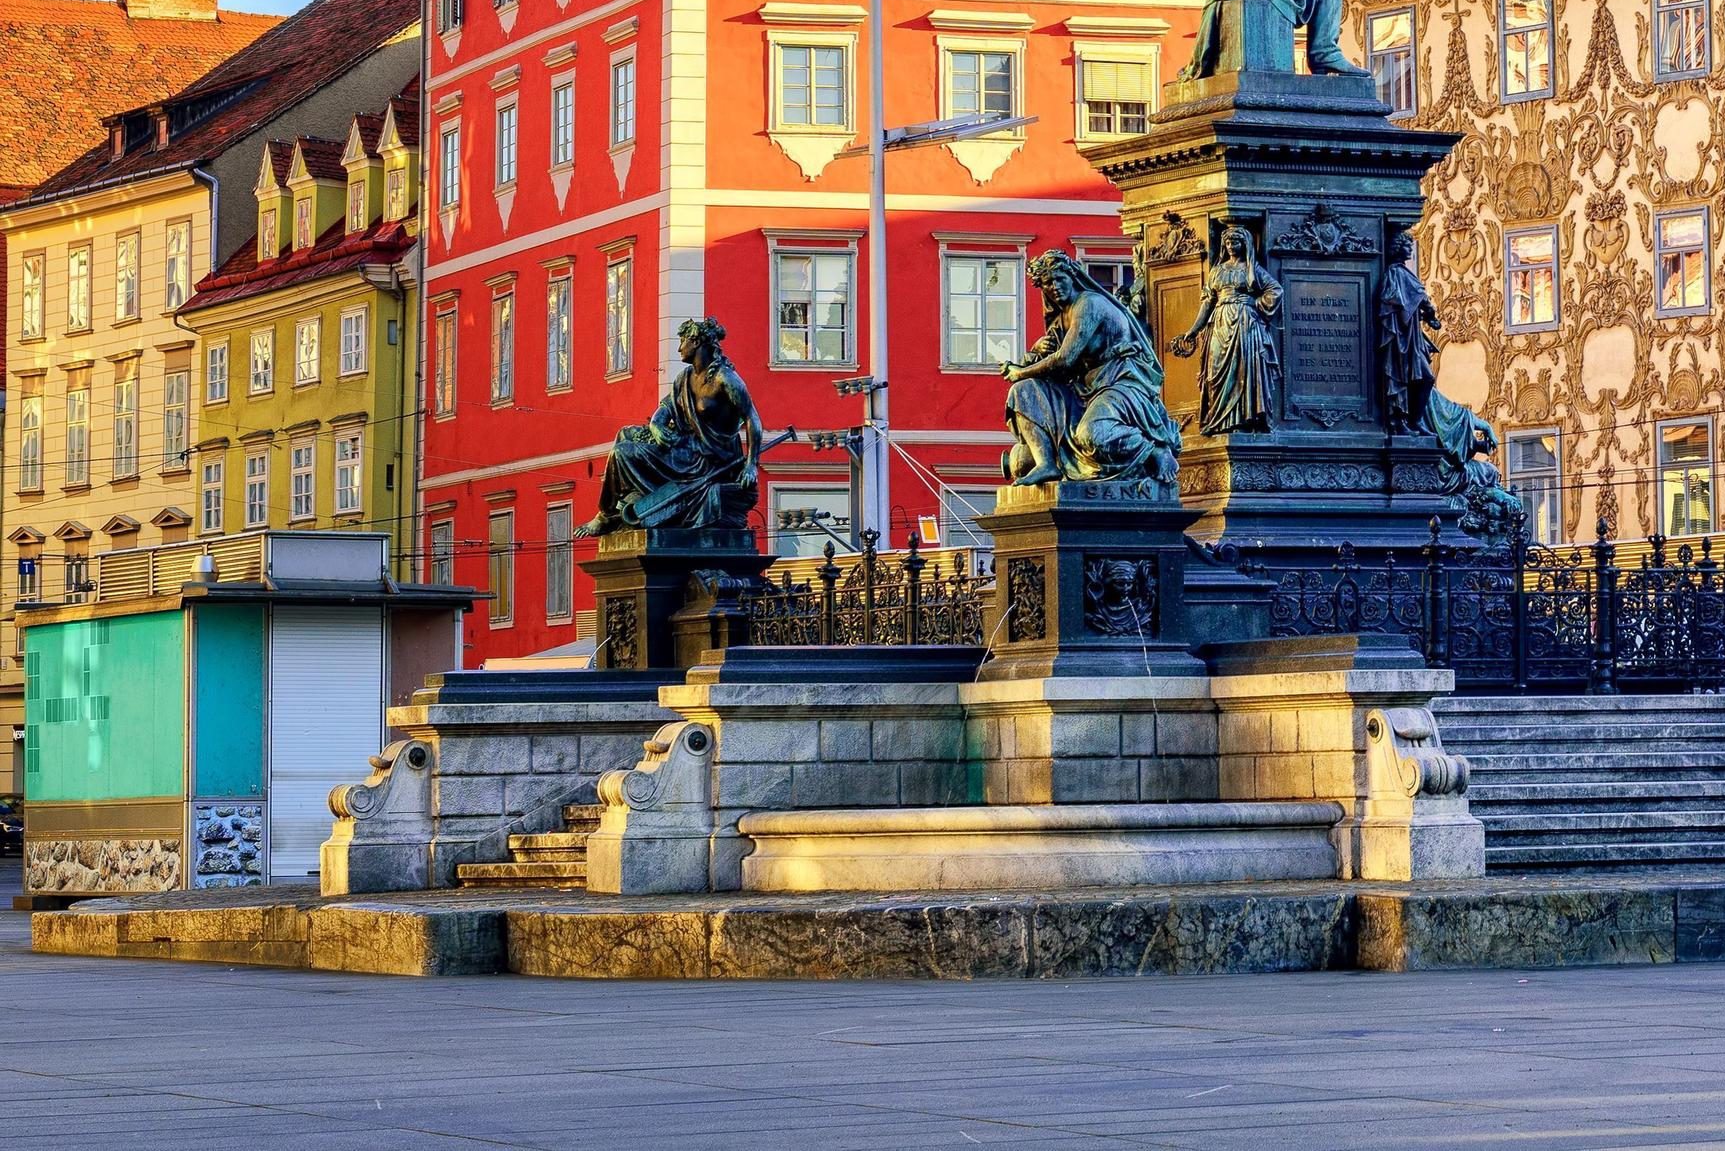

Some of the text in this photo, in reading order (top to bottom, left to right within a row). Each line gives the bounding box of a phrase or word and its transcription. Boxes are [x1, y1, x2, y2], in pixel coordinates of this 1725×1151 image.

[1300, 297, 1316, 306] EIN
[1298, 358, 1316, 367] DES
[1086, 481, 1152, 500] SANN
